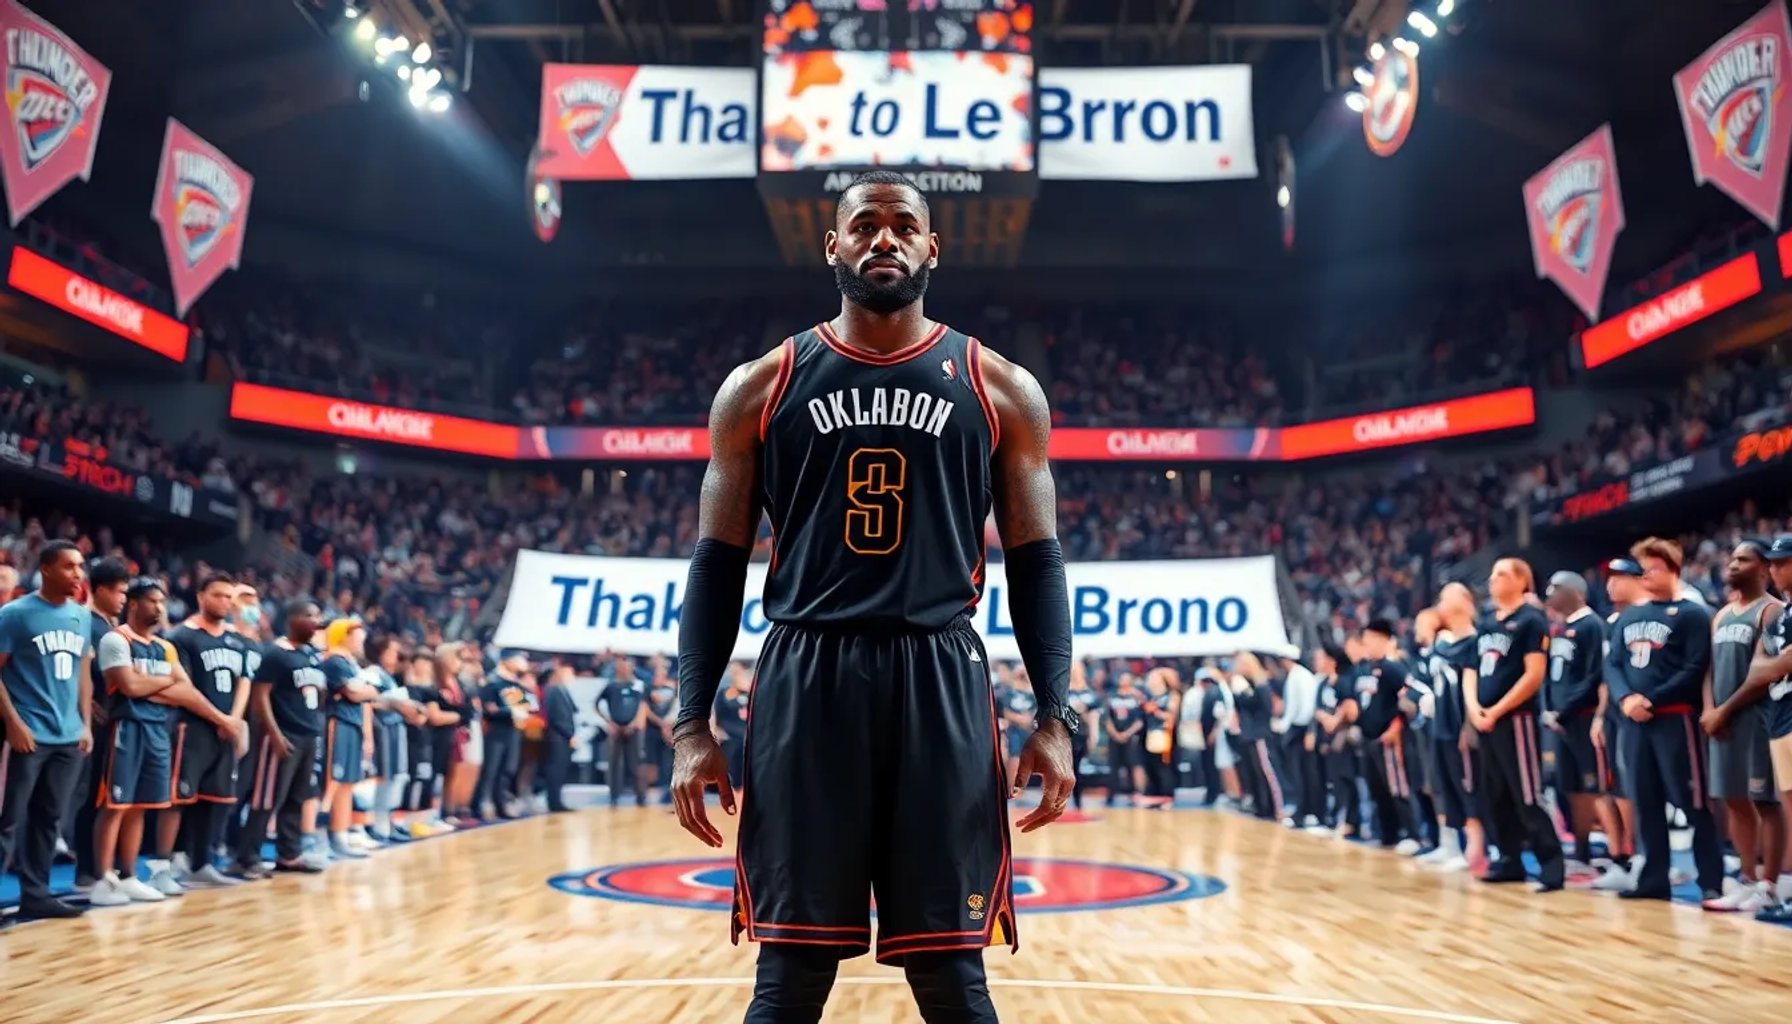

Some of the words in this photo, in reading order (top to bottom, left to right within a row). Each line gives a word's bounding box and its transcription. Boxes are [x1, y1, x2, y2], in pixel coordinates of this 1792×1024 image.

[640, 89, 748, 143] Tha
[850, 90, 900, 137] to
[924, 83, 1003, 140] Le
[1038, 86, 1221, 142] Brron
[808, 388, 964, 438] OKLABON
[982, 586, 1015, 635] L
[1073, 586, 1249, 635] Brono
